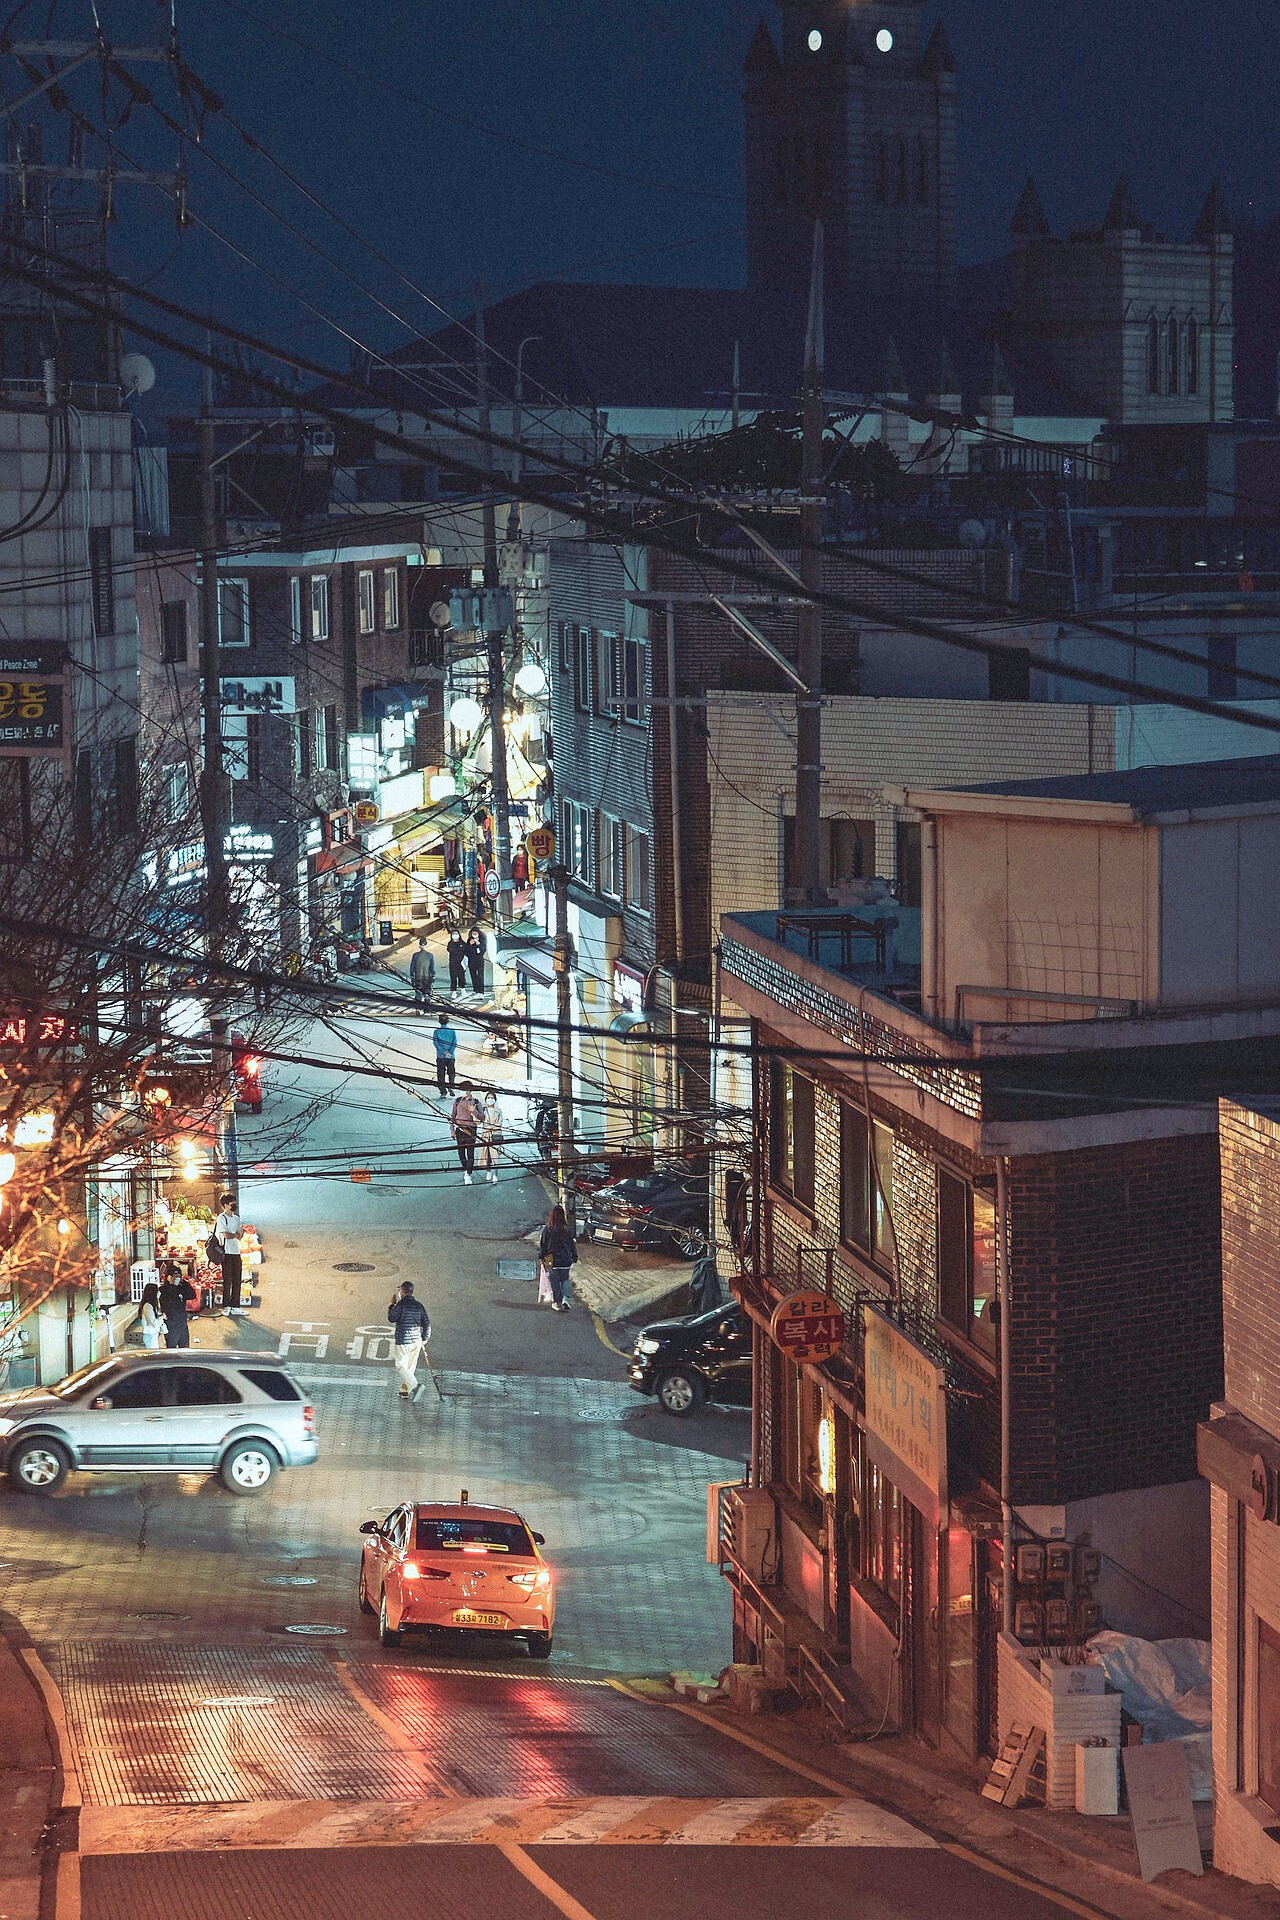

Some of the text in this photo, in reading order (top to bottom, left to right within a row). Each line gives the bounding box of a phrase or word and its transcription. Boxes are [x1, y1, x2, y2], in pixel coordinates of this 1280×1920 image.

[4, 660, 22, 669] Peace
[531, 834, 551, 857] 빵
[489, 879, 497, 890] 20
[789, 1300, 829, 1316] 칼라
[782, 1318, 839, 1341] 복사
[792, 1343, 831, 1357] 출력
